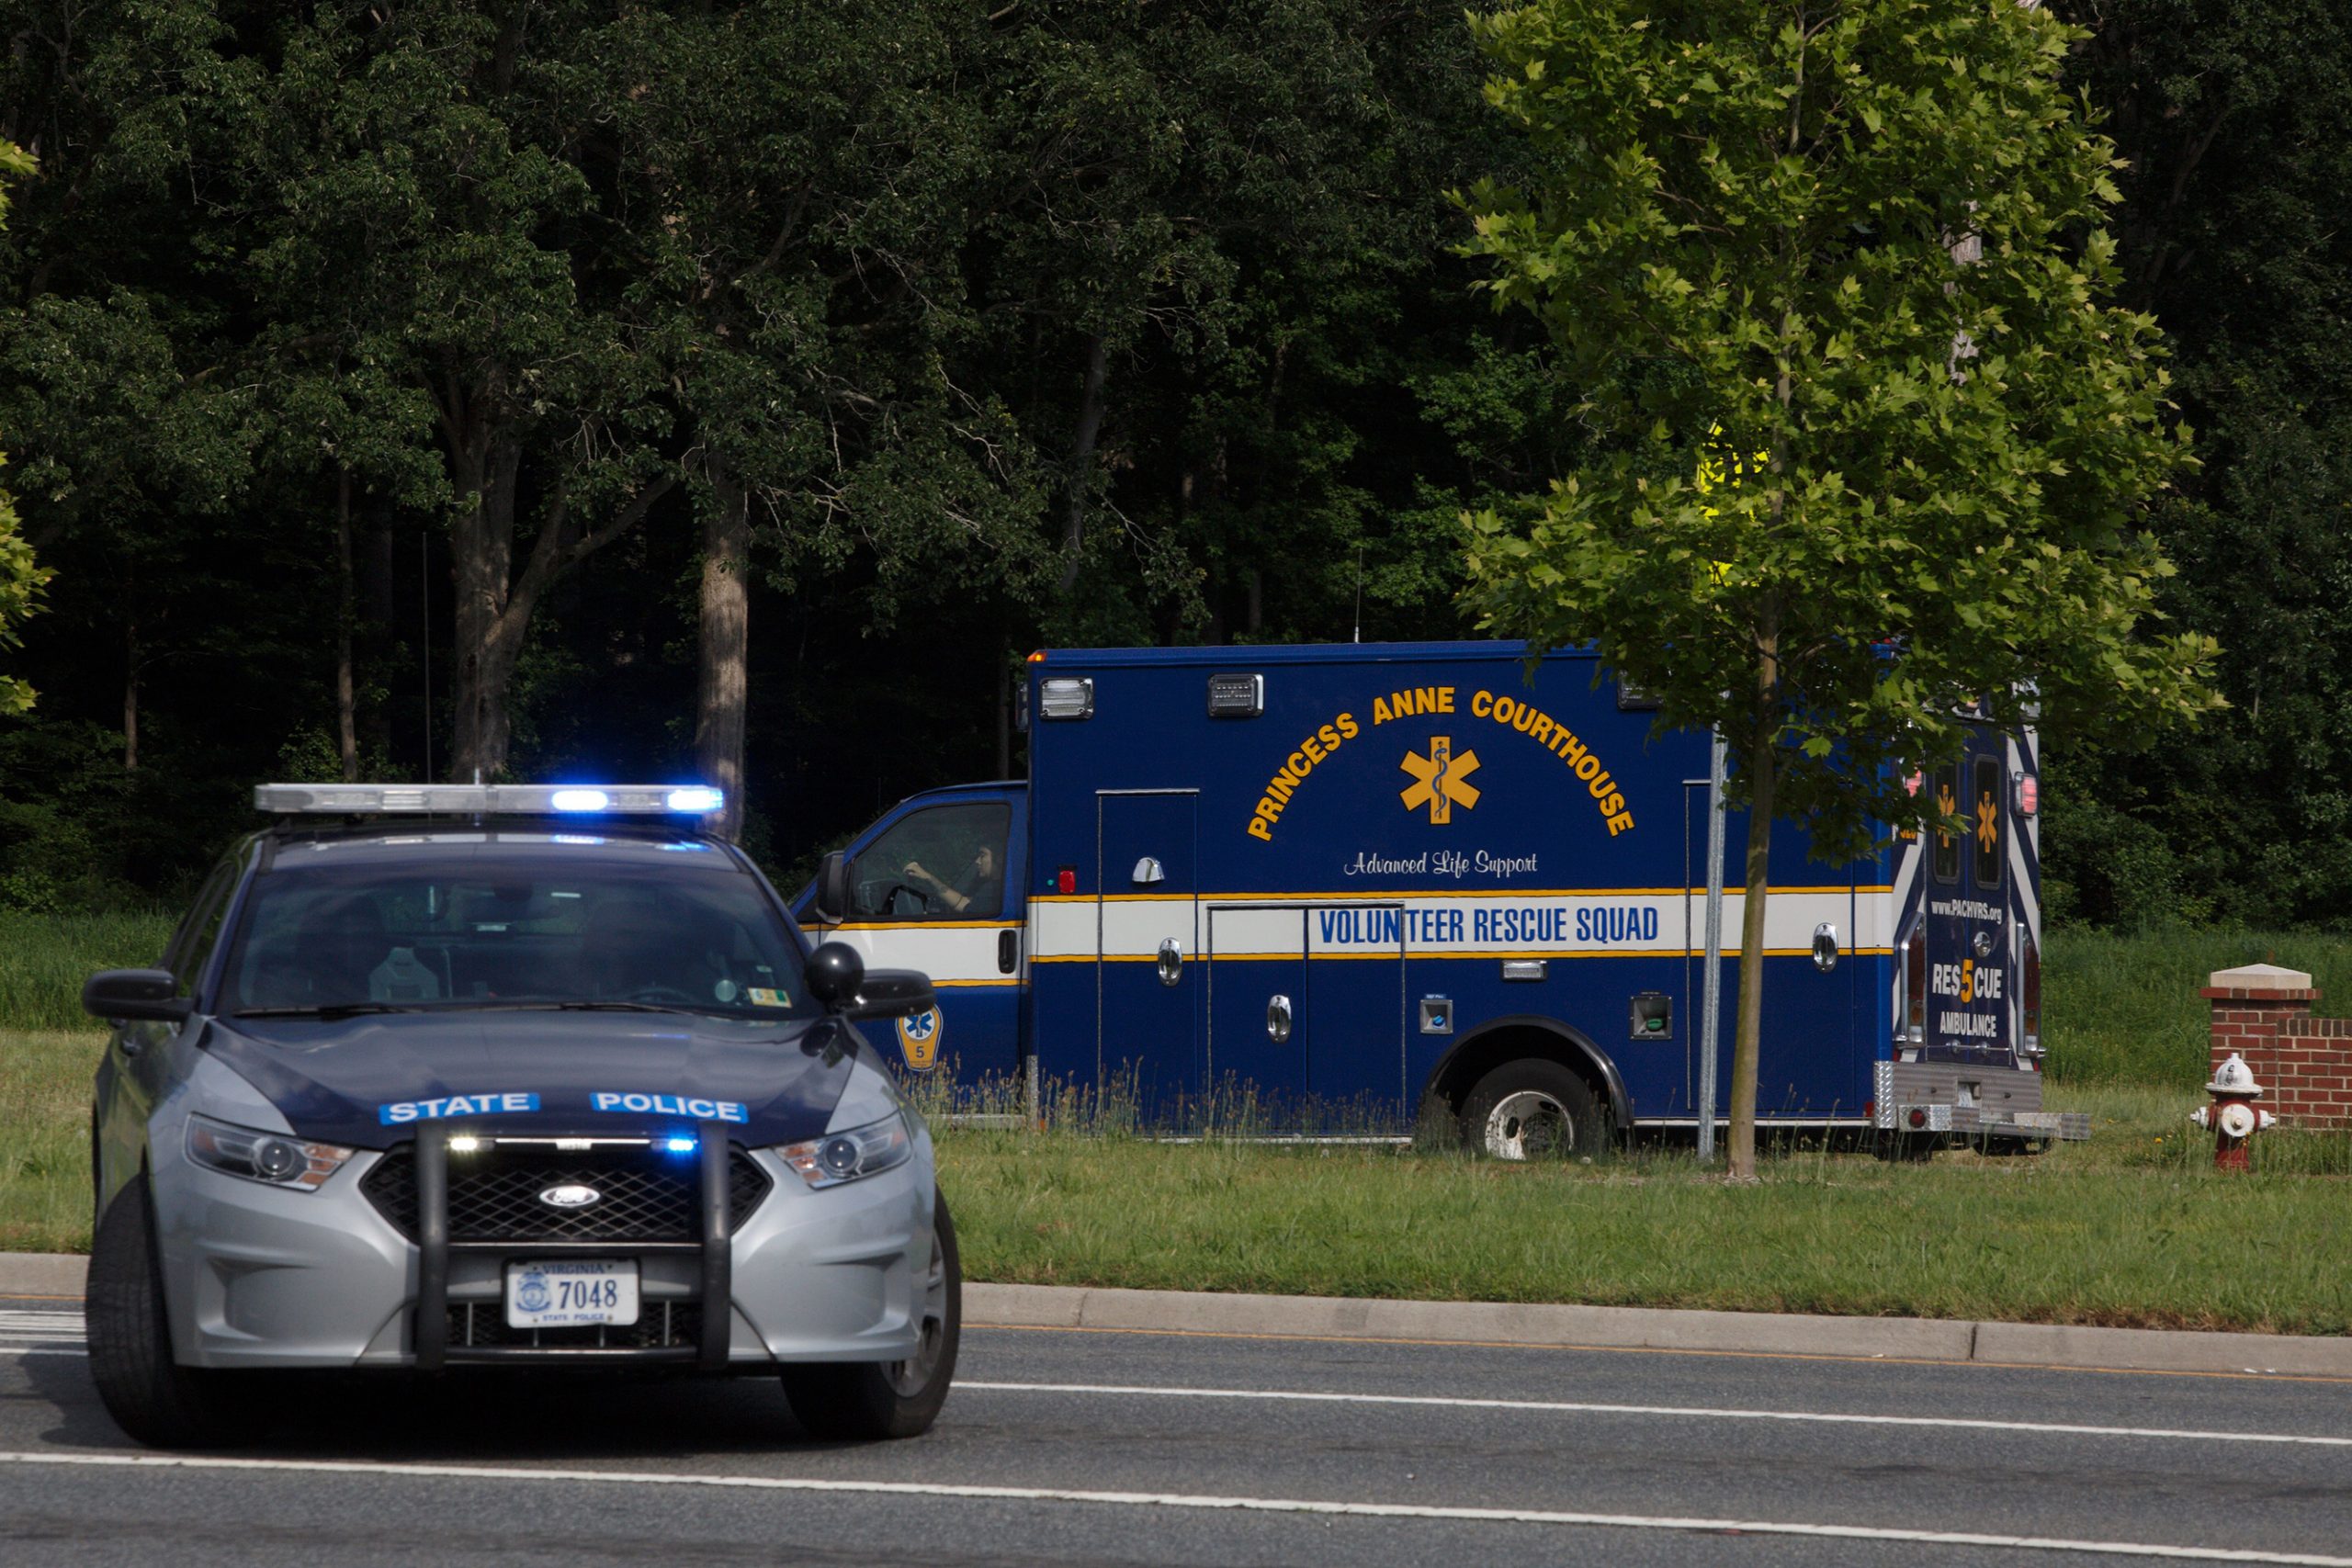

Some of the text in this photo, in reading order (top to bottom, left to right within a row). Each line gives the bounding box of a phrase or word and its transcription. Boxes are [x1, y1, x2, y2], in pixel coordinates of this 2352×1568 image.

[1248, 686, 1634, 841] PRINCESS ANNE COURTHOUSE
[1343, 851, 1538, 878] Advanced Life Support
[1319, 907, 1658, 943] VOLUNTEER RESCUE SQUAD
[1939, 1011, 1996, 1038] AMBULANCE
[916, 1045, 925, 1058] 5
[389, 1093, 741, 1122] STATE POLICE
[542, 1263, 605, 1275] VIRGINIA
[559, 1280, 617, 1310] 7048
[574, 1313, 605, 1321] POLICE
